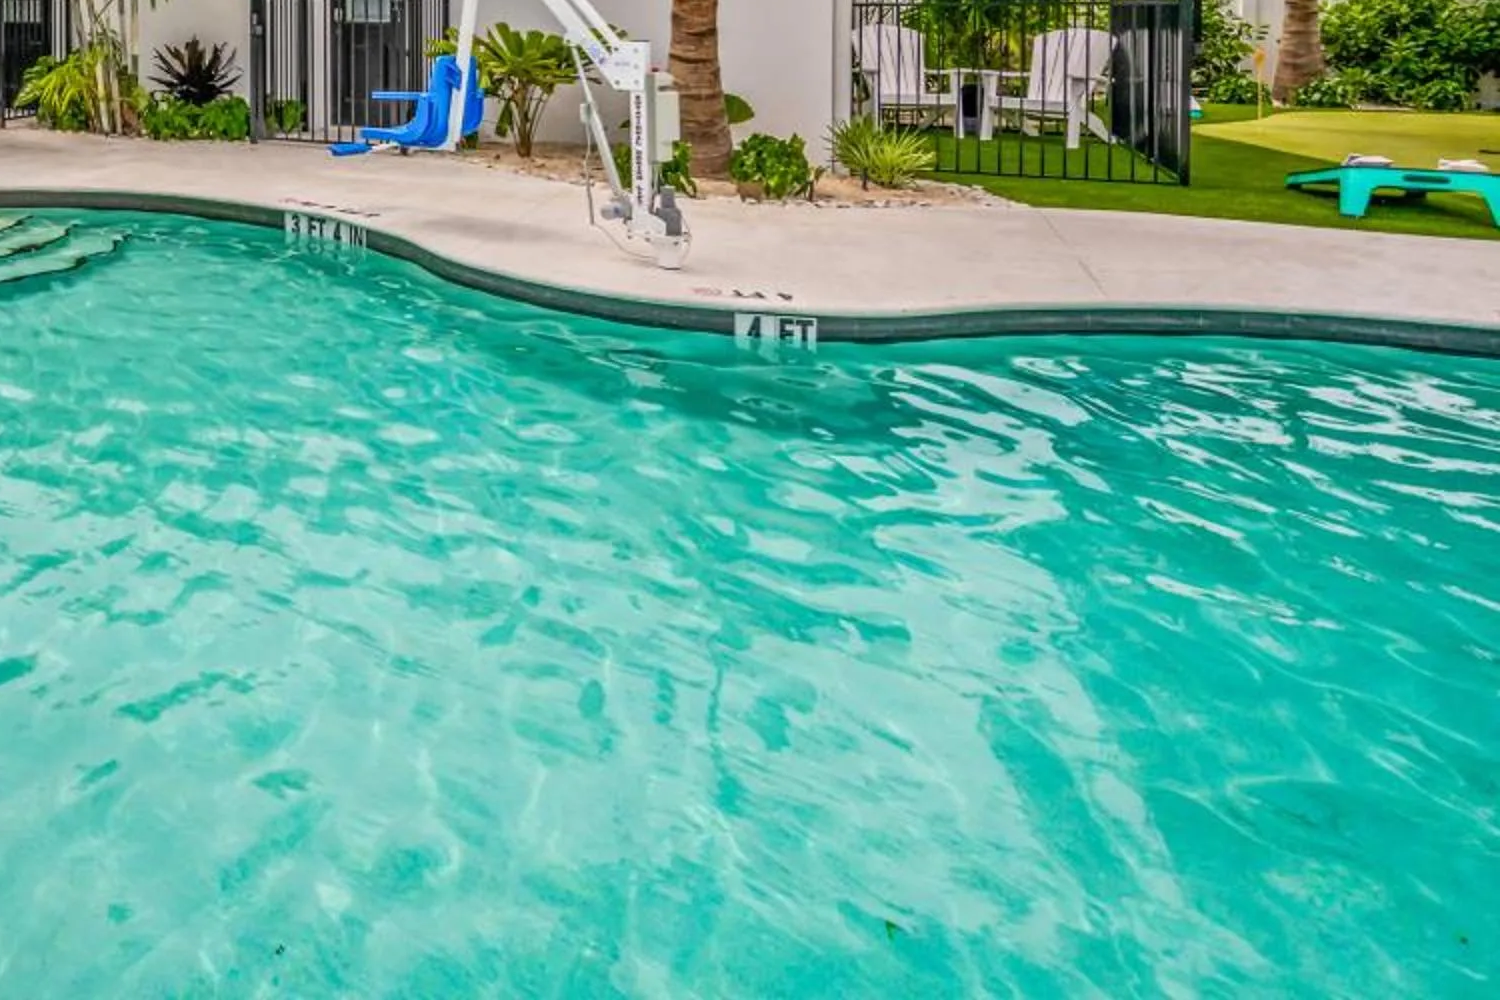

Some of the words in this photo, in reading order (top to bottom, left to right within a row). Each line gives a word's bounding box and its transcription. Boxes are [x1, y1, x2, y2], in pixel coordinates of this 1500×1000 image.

[291, 214, 300, 234] 3
[307, 217, 326, 238] FT
[333, 221, 342, 241] 4
[349, 223, 363, 247] IN
[779, 317, 815, 343] FT
